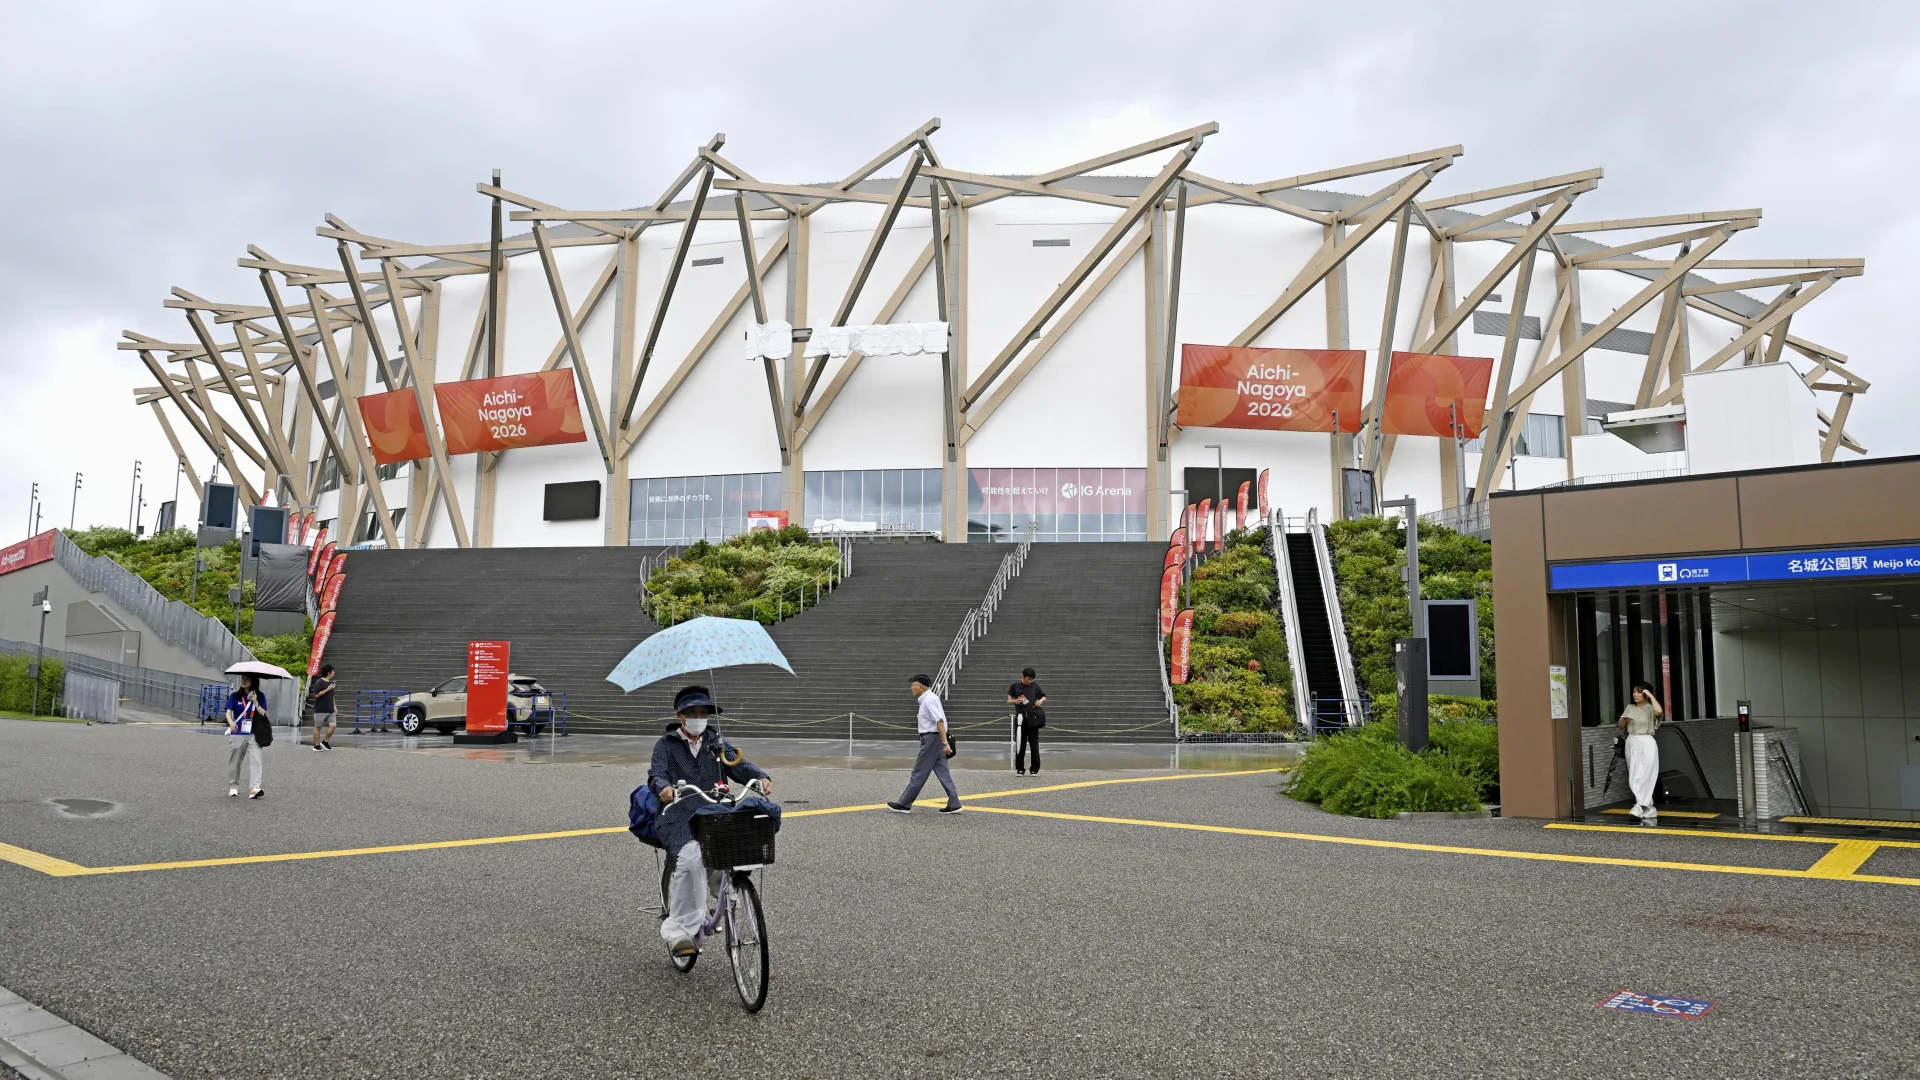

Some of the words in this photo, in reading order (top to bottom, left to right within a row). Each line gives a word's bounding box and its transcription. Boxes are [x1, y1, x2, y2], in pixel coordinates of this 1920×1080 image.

[1246, 364, 1300, 380] Aichi-
[483, 389, 524, 406] Aichi-
[1237, 380, 1306, 400] Nagoya
[478, 406, 532, 423] Nagoya
[1247, 402, 1292, 417] 2026
[491, 424, 526, 438] 2026
[1081, 486, 1093, 496] IG
[1096, 486, 1132, 496] Arena
[1788, 556, 1868, 572] 名城公園駅
[1874, 560, 1904, 570] Meijo
[1181, 618, 1190, 662] Aichi-Nagoya
